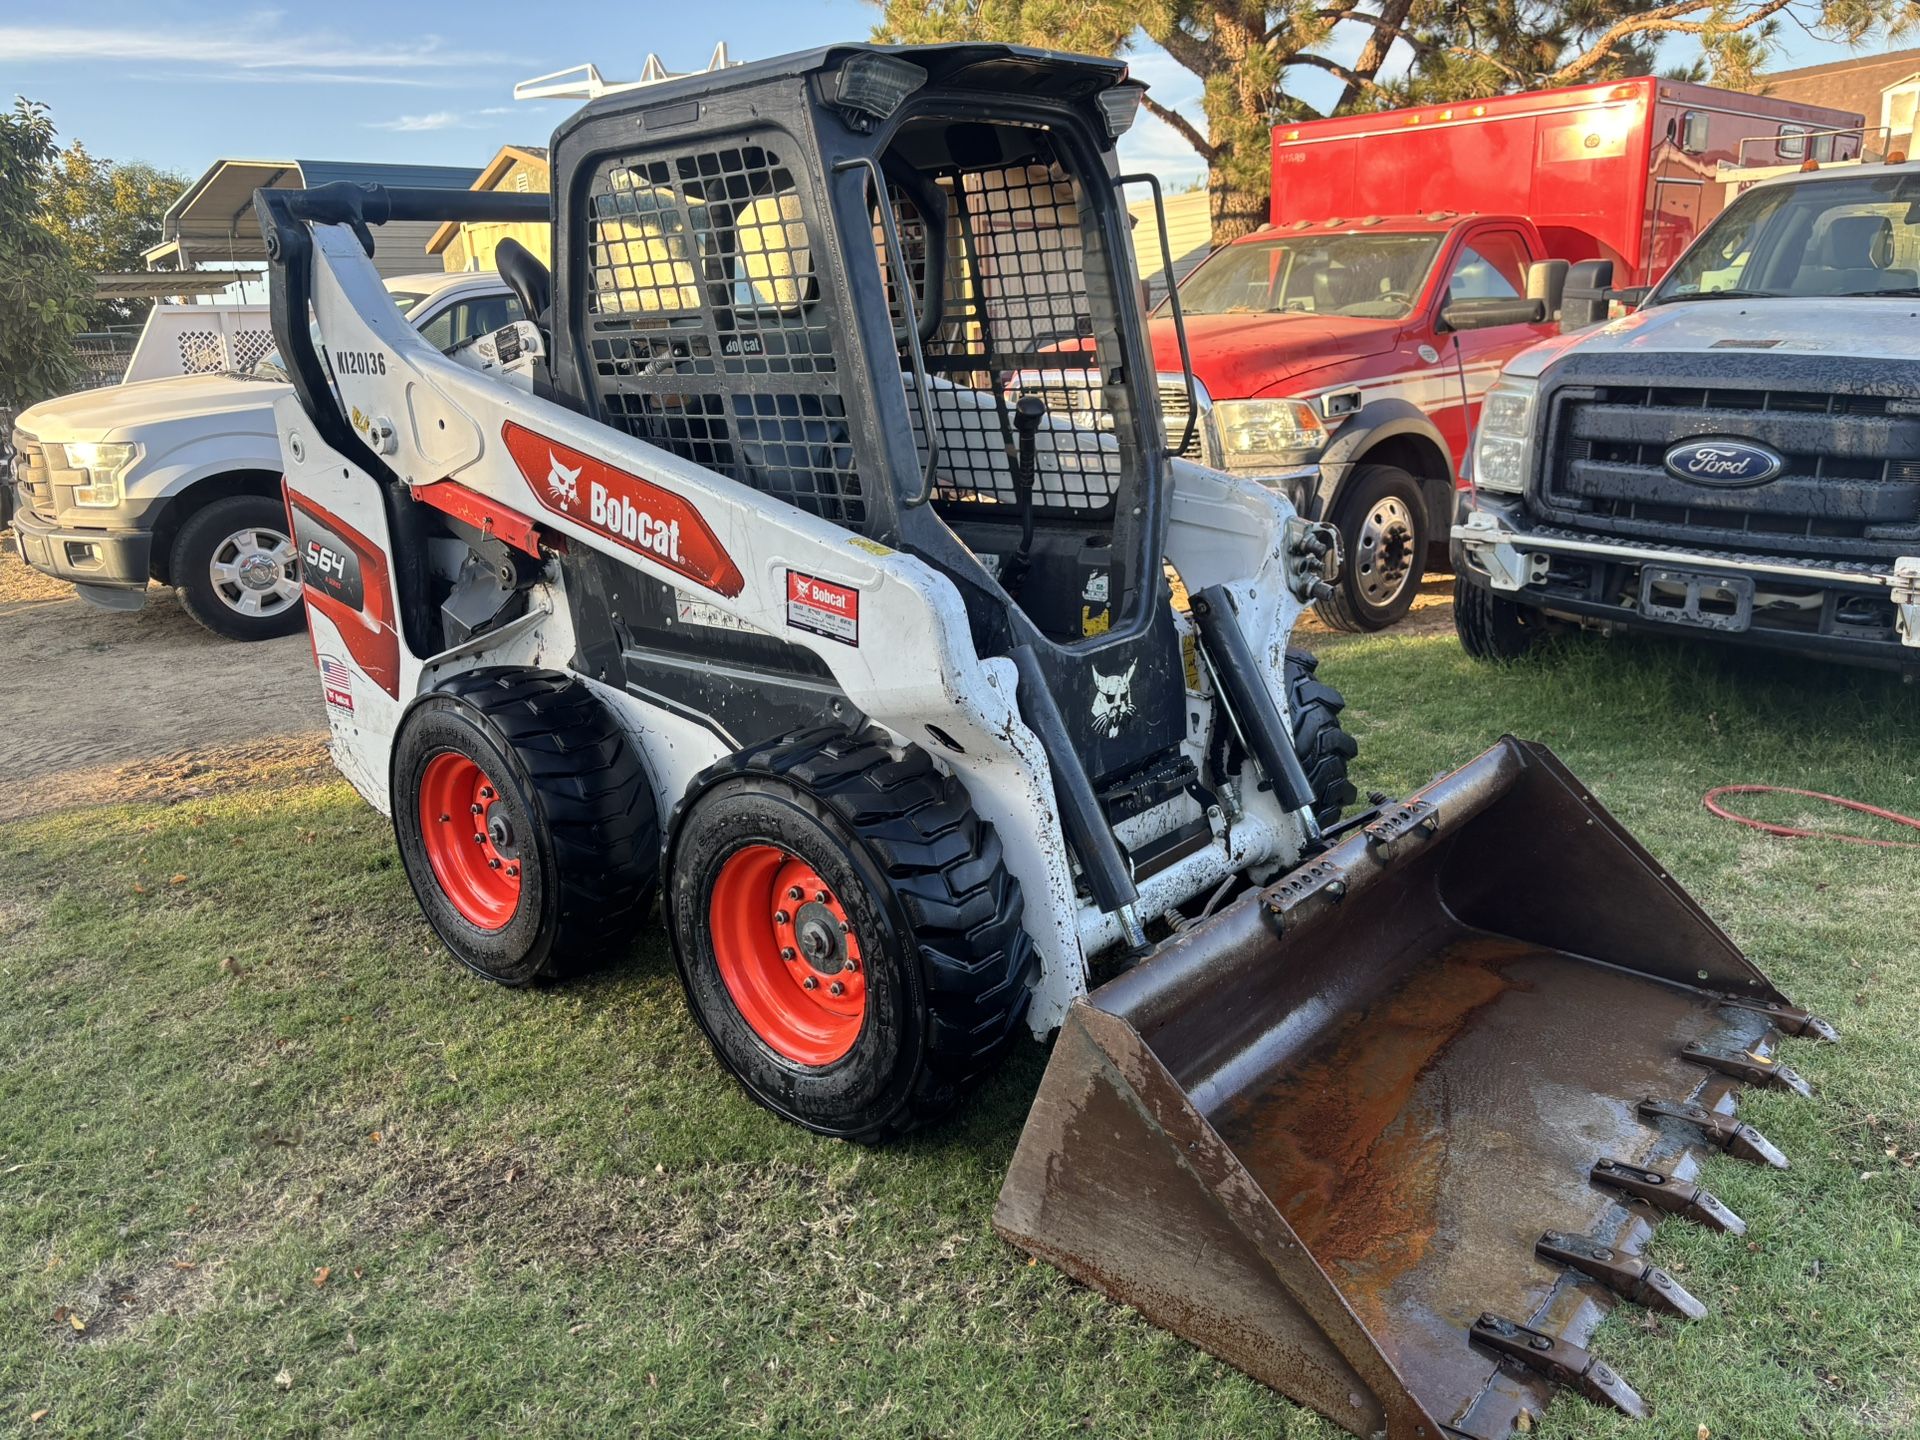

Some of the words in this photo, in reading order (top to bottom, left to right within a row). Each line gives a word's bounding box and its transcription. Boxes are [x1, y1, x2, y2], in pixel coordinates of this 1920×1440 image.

[1688, 448, 1751, 474] Ford
[590, 481, 681, 562] Bobcat
[306, 541, 345, 579] S64
[812, 585, 846, 609] Bobcat
